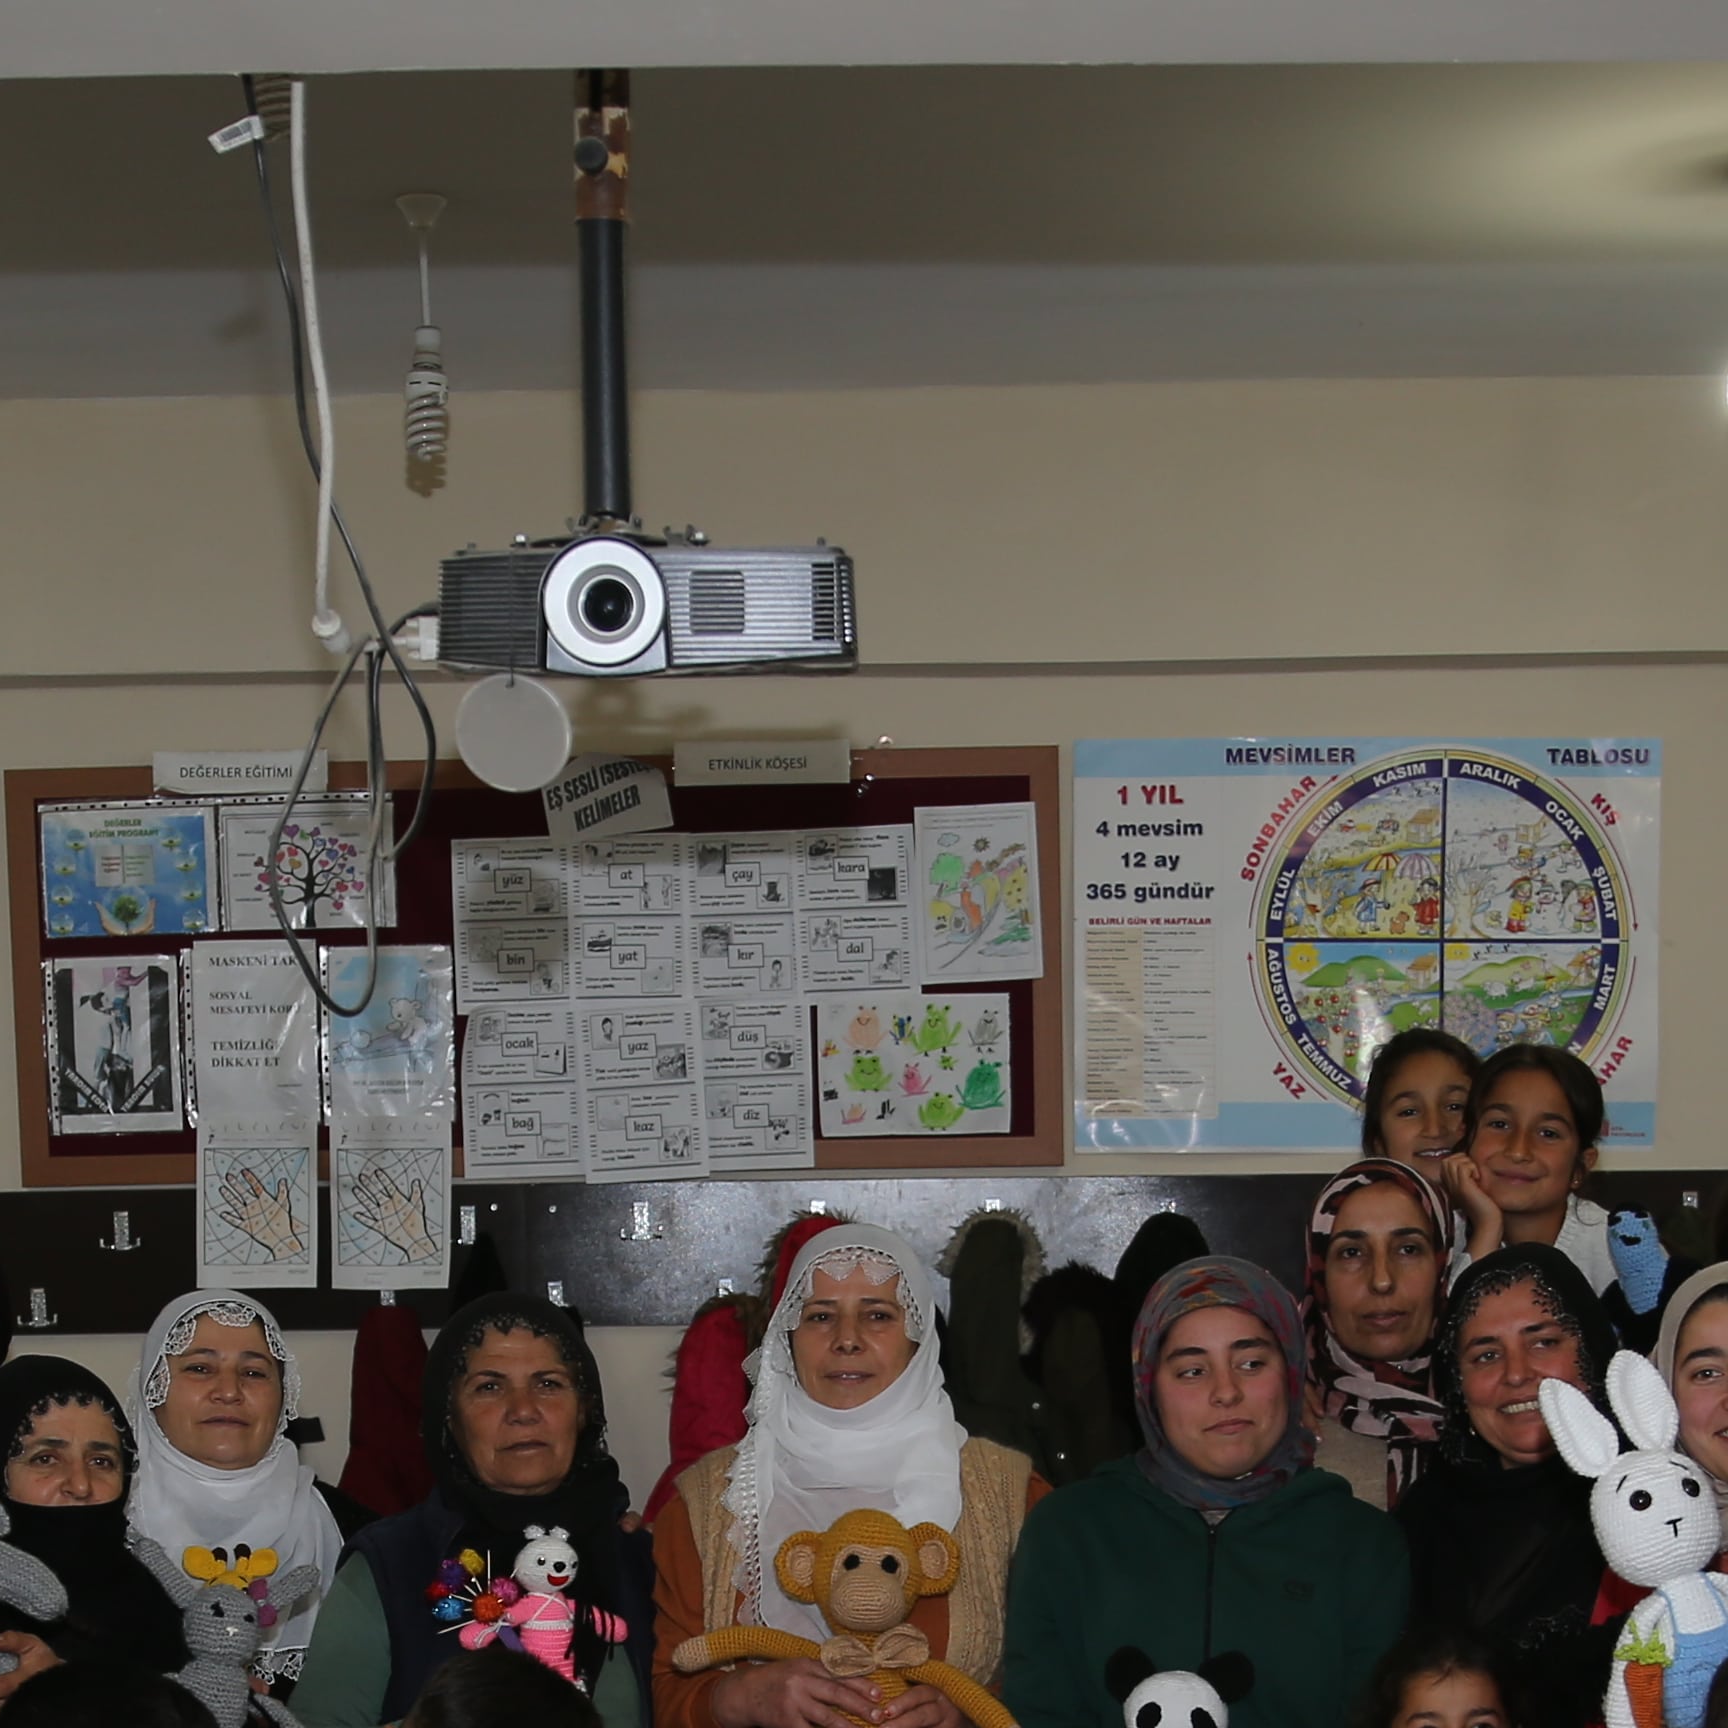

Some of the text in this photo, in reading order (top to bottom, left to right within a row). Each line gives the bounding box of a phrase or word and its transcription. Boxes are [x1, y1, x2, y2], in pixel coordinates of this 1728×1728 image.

[1226, 744, 1650, 765] MEVSİMLER TABLOSU
[180, 764, 293, 779] DEĞERLER EĞİTİMİ
[708, 757, 808, 771] ETKİNLİK KÖŞESİ
[1373, 762, 1427, 788] KASIM
[1459, 762, 1522, 790] ARALIK
[546, 789, 564, 811] EŞ
[564, 766, 599, 802] SESLİ
[1117, 784, 1184, 805] 1 YIL
[574, 784, 641, 832] KELİMELER
[1590, 792, 1620, 826] KIŞ
[1306, 801, 1344, 838] EKİM
[1545, 801, 1584, 840] OCAK
[1096, 819, 1203, 837] 4 mevsim
[1241, 775, 1317, 881] SONBAHAR
[837, 861, 865, 873] kara
[1121, 852, 1180, 871] 12 ay
[502, 873, 524, 888] yüz
[620, 870, 633, 880] at
[732, 870, 754, 883] çay
[1086, 882, 1215, 903] 365 gündür
[1269, 867, 1295, 921] EYLÜL
[1592, 866, 1618, 920] ŞUBAT
[737, 950, 754, 960] kır
[846, 942, 864, 954] dal
[209, 954, 297, 967] MASKENİ TAK
[506, 952, 526, 965] bin
[618, 951, 638, 965] yat
[1267, 948, 1297, 1025] AĞUSTOS
[1593, 963, 1616, 1011] MART
[209, 991, 253, 1001] SOSYAL
[210, 1003, 267, 1015] MESAFEYİ
[505, 1037, 535, 1050] ocak
[737, 1030, 759, 1043] düş
[211, 1038, 276, 1051] TEMİZLİĞ
[627, 1041, 649, 1055] yaz
[211, 1056, 280, 1068] DİKKAT ET
[1297, 1033, 1352, 1090] TEMMUZ
[1272, 1062, 1307, 1100] YAZ
[743, 1109, 760, 1120] diz
[512, 1116, 534, 1130] bağ
[633, 1121, 655, 1132] kaz
